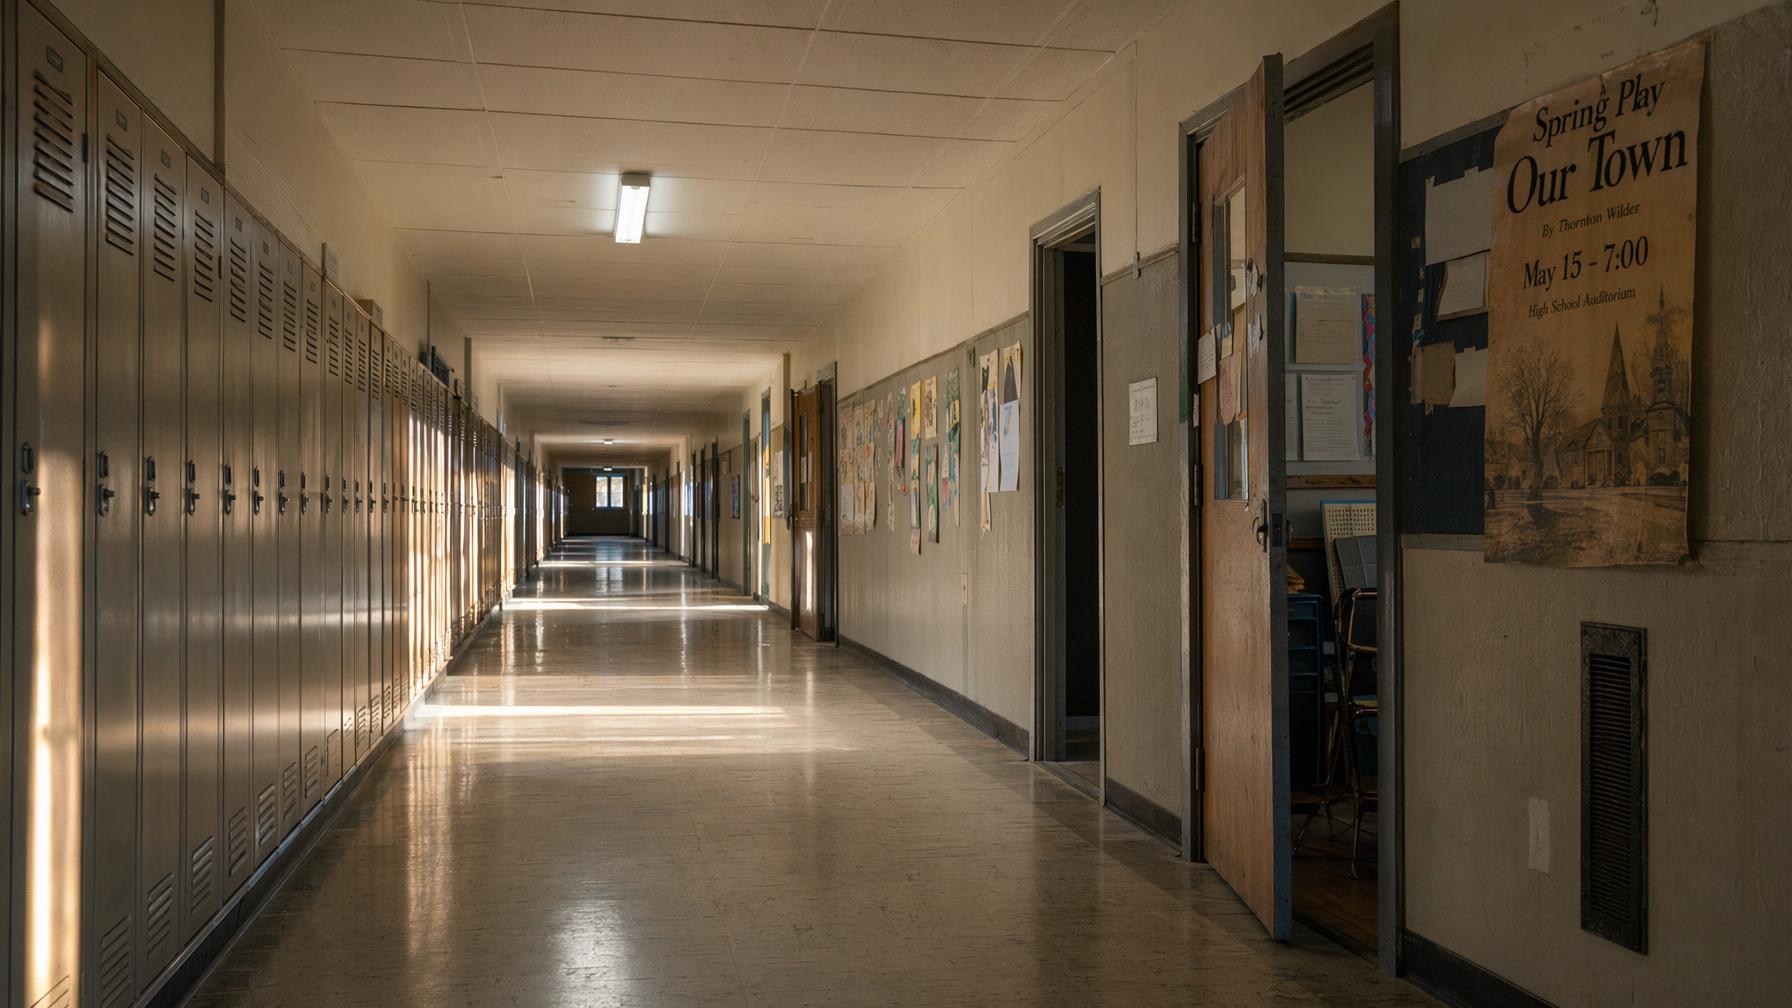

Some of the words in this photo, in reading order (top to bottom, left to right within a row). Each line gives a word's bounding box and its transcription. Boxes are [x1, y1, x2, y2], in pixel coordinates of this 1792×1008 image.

[1533, 96, 1610, 148] Spring
[1615, 73, 1666, 117] Play
[1507, 155, 1577, 214] Our
[1587, 129, 1688, 192] Town
[1542, 224, 1555, 239] By
[1558, 213, 1603, 233] Thornton
[1607, 202, 1641, 221] Wilder
[1522, 260, 1557, 291] May
[1562, 251, 1582, 281] 15
[1603, 236, 1649, 272] 7:00
[1528, 302, 1548, 319] High
[1551, 294, 1581, 314] School
[1583, 288, 1636, 308] Auditorium
